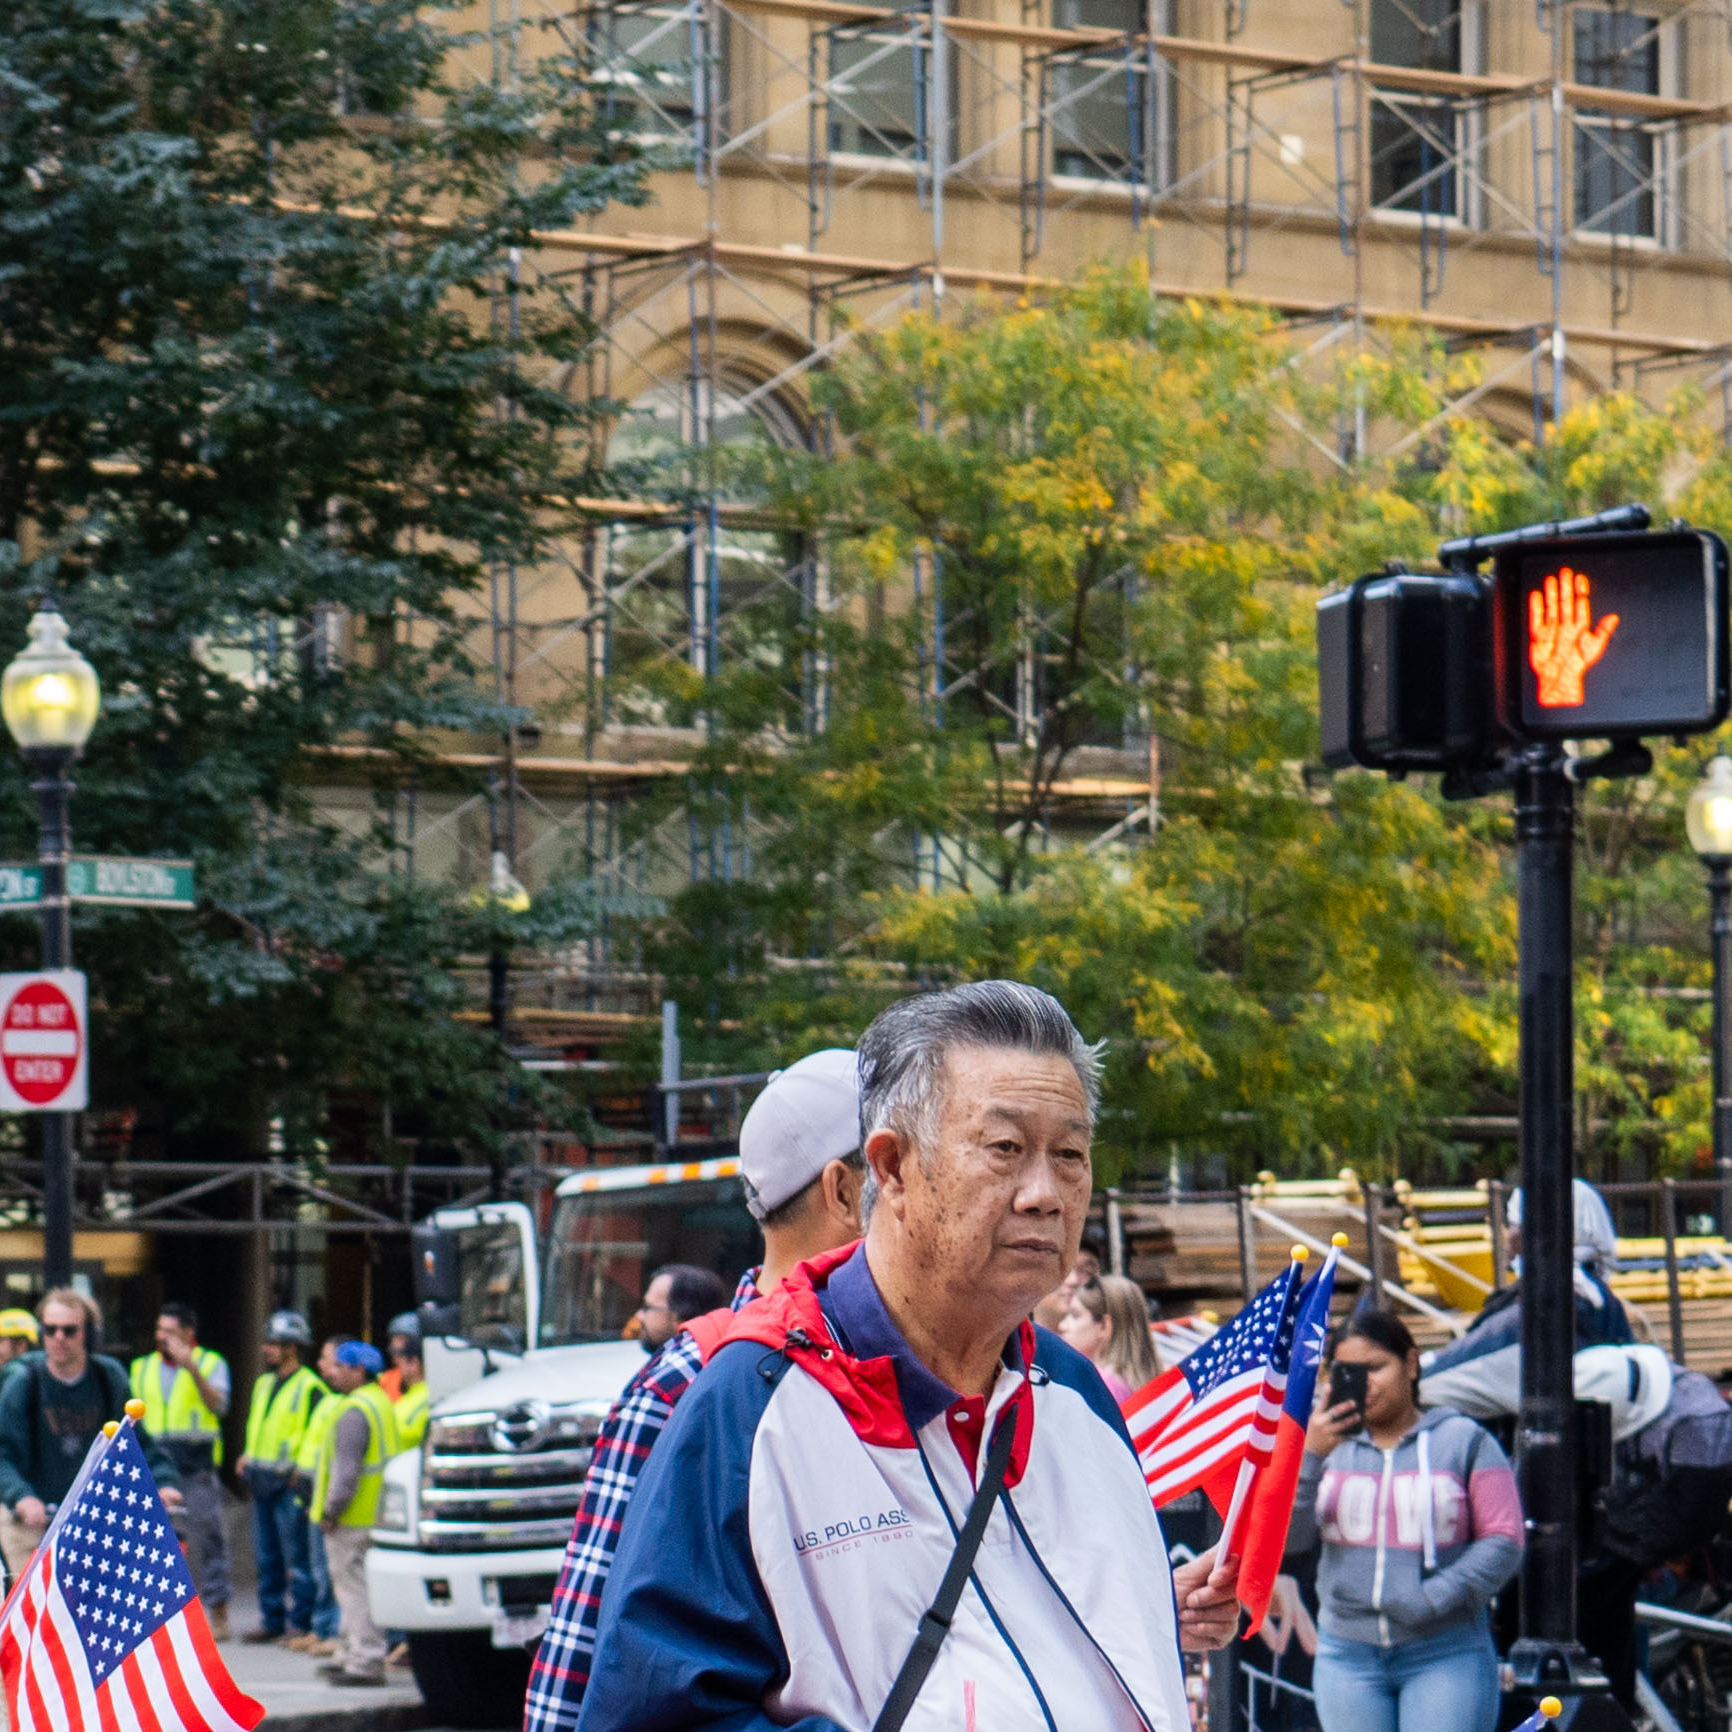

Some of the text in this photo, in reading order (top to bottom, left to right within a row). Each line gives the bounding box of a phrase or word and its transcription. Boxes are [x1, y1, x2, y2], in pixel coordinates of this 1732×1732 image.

[11, 1004, 67, 1026] DO NOT
[15, 1060, 63, 1083] ENTER
[1315, 1473, 1466, 1546] LOVE
[793, 1531, 822, 1551] U.S.
[824, 1515, 872, 1541] POLO
[815, 1541, 862, 1560] SINCE
